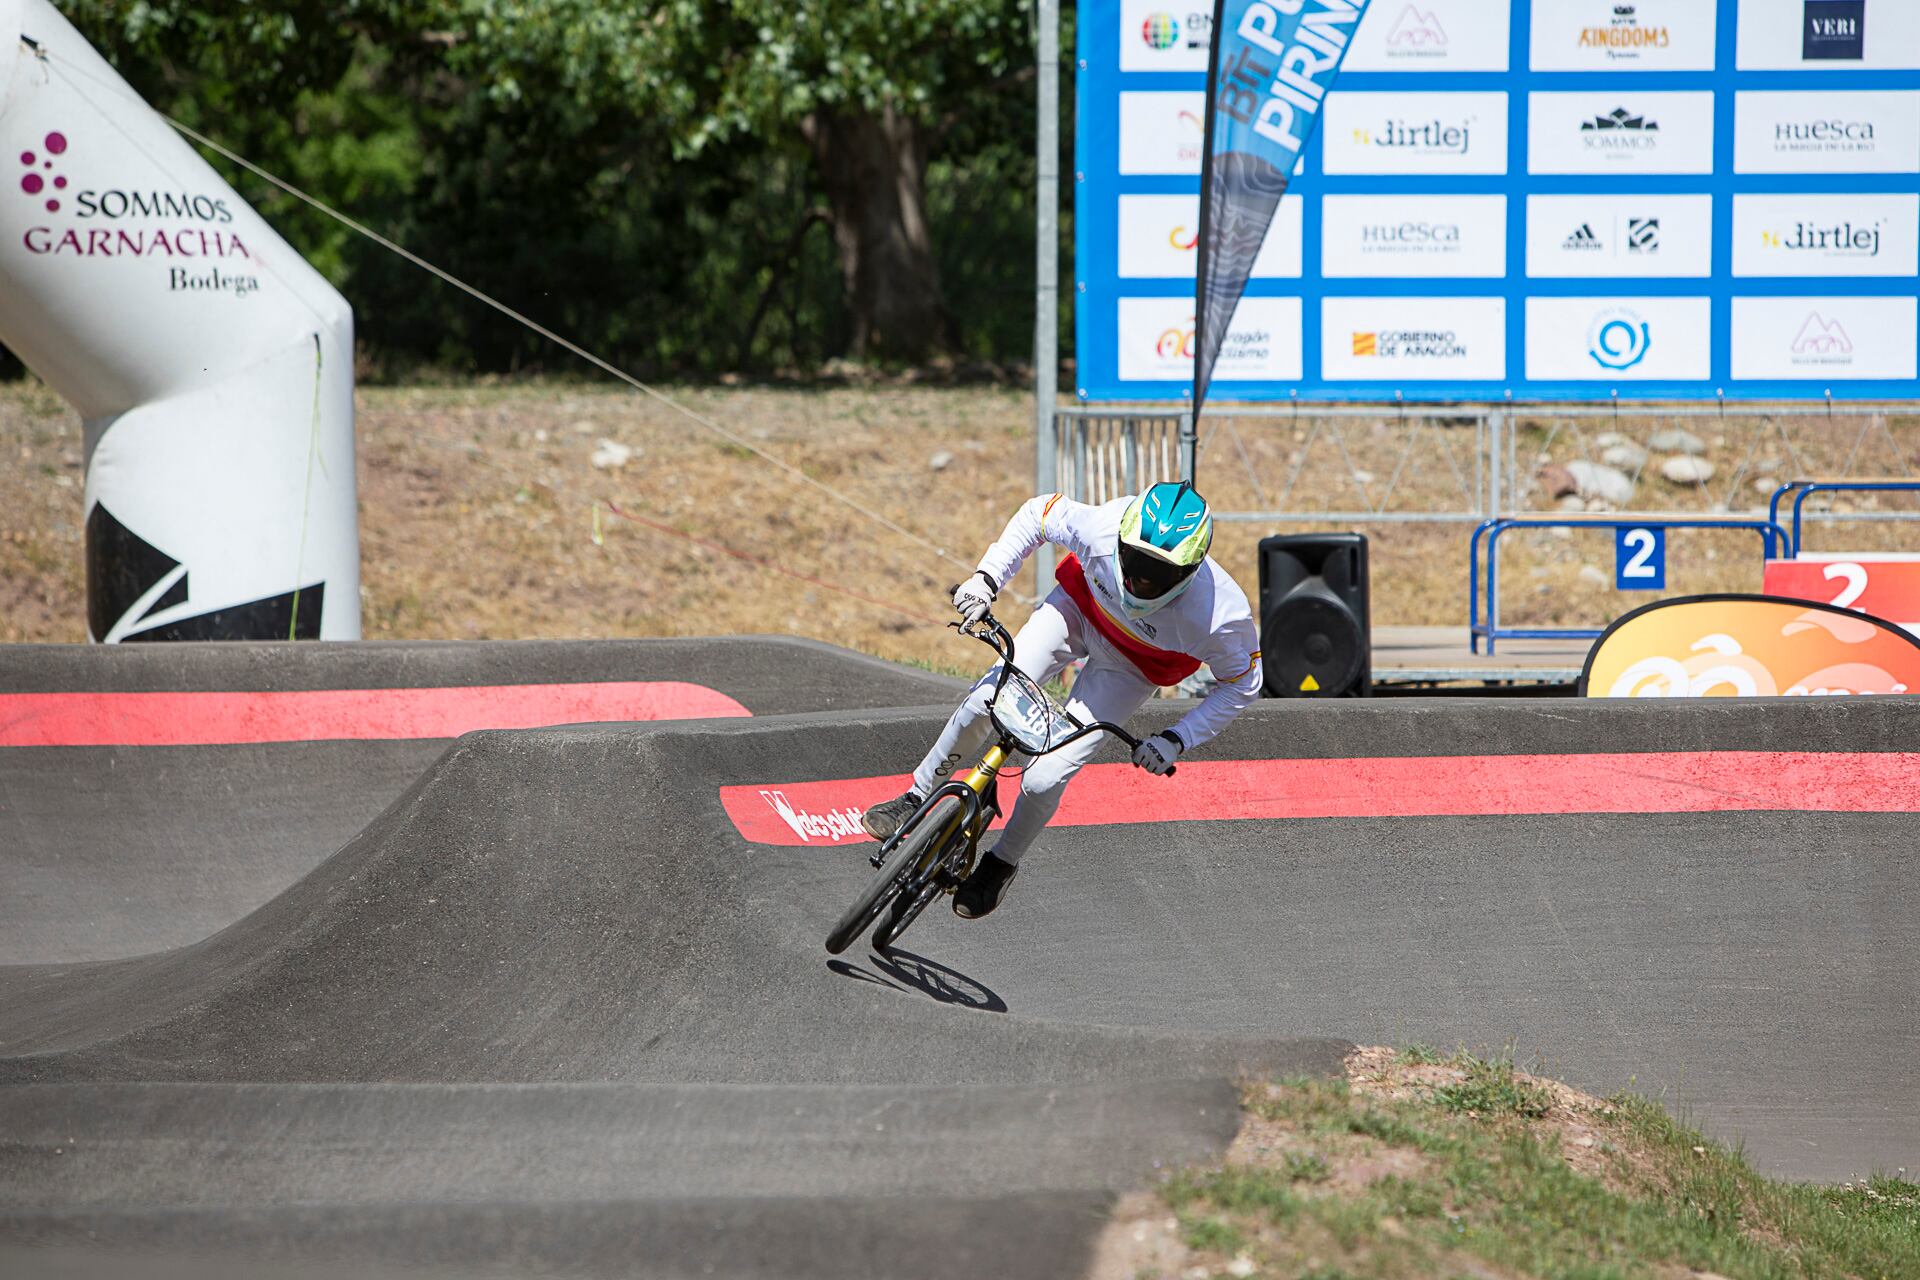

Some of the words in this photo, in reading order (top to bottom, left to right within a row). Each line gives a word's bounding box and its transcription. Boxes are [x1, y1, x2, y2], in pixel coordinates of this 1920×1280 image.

[1812, 18, 1856, 35] VERI
[1253, 0, 1368, 153] PIRIN
[1375, 119, 1469, 154] dirtlej
[1583, 135, 1657, 150] SOMMOS
[76, 190, 233, 223] SOMMOS
[23, 227, 250, 257] GARNACHA
[1785, 221, 1879, 256] dirtlej
[169, 266, 260, 296] Bodega
[1380, 331, 1456, 342] GOBIERNO
[1622, 528, 1656, 578] 2
[1822, 562, 1868, 613] 2
